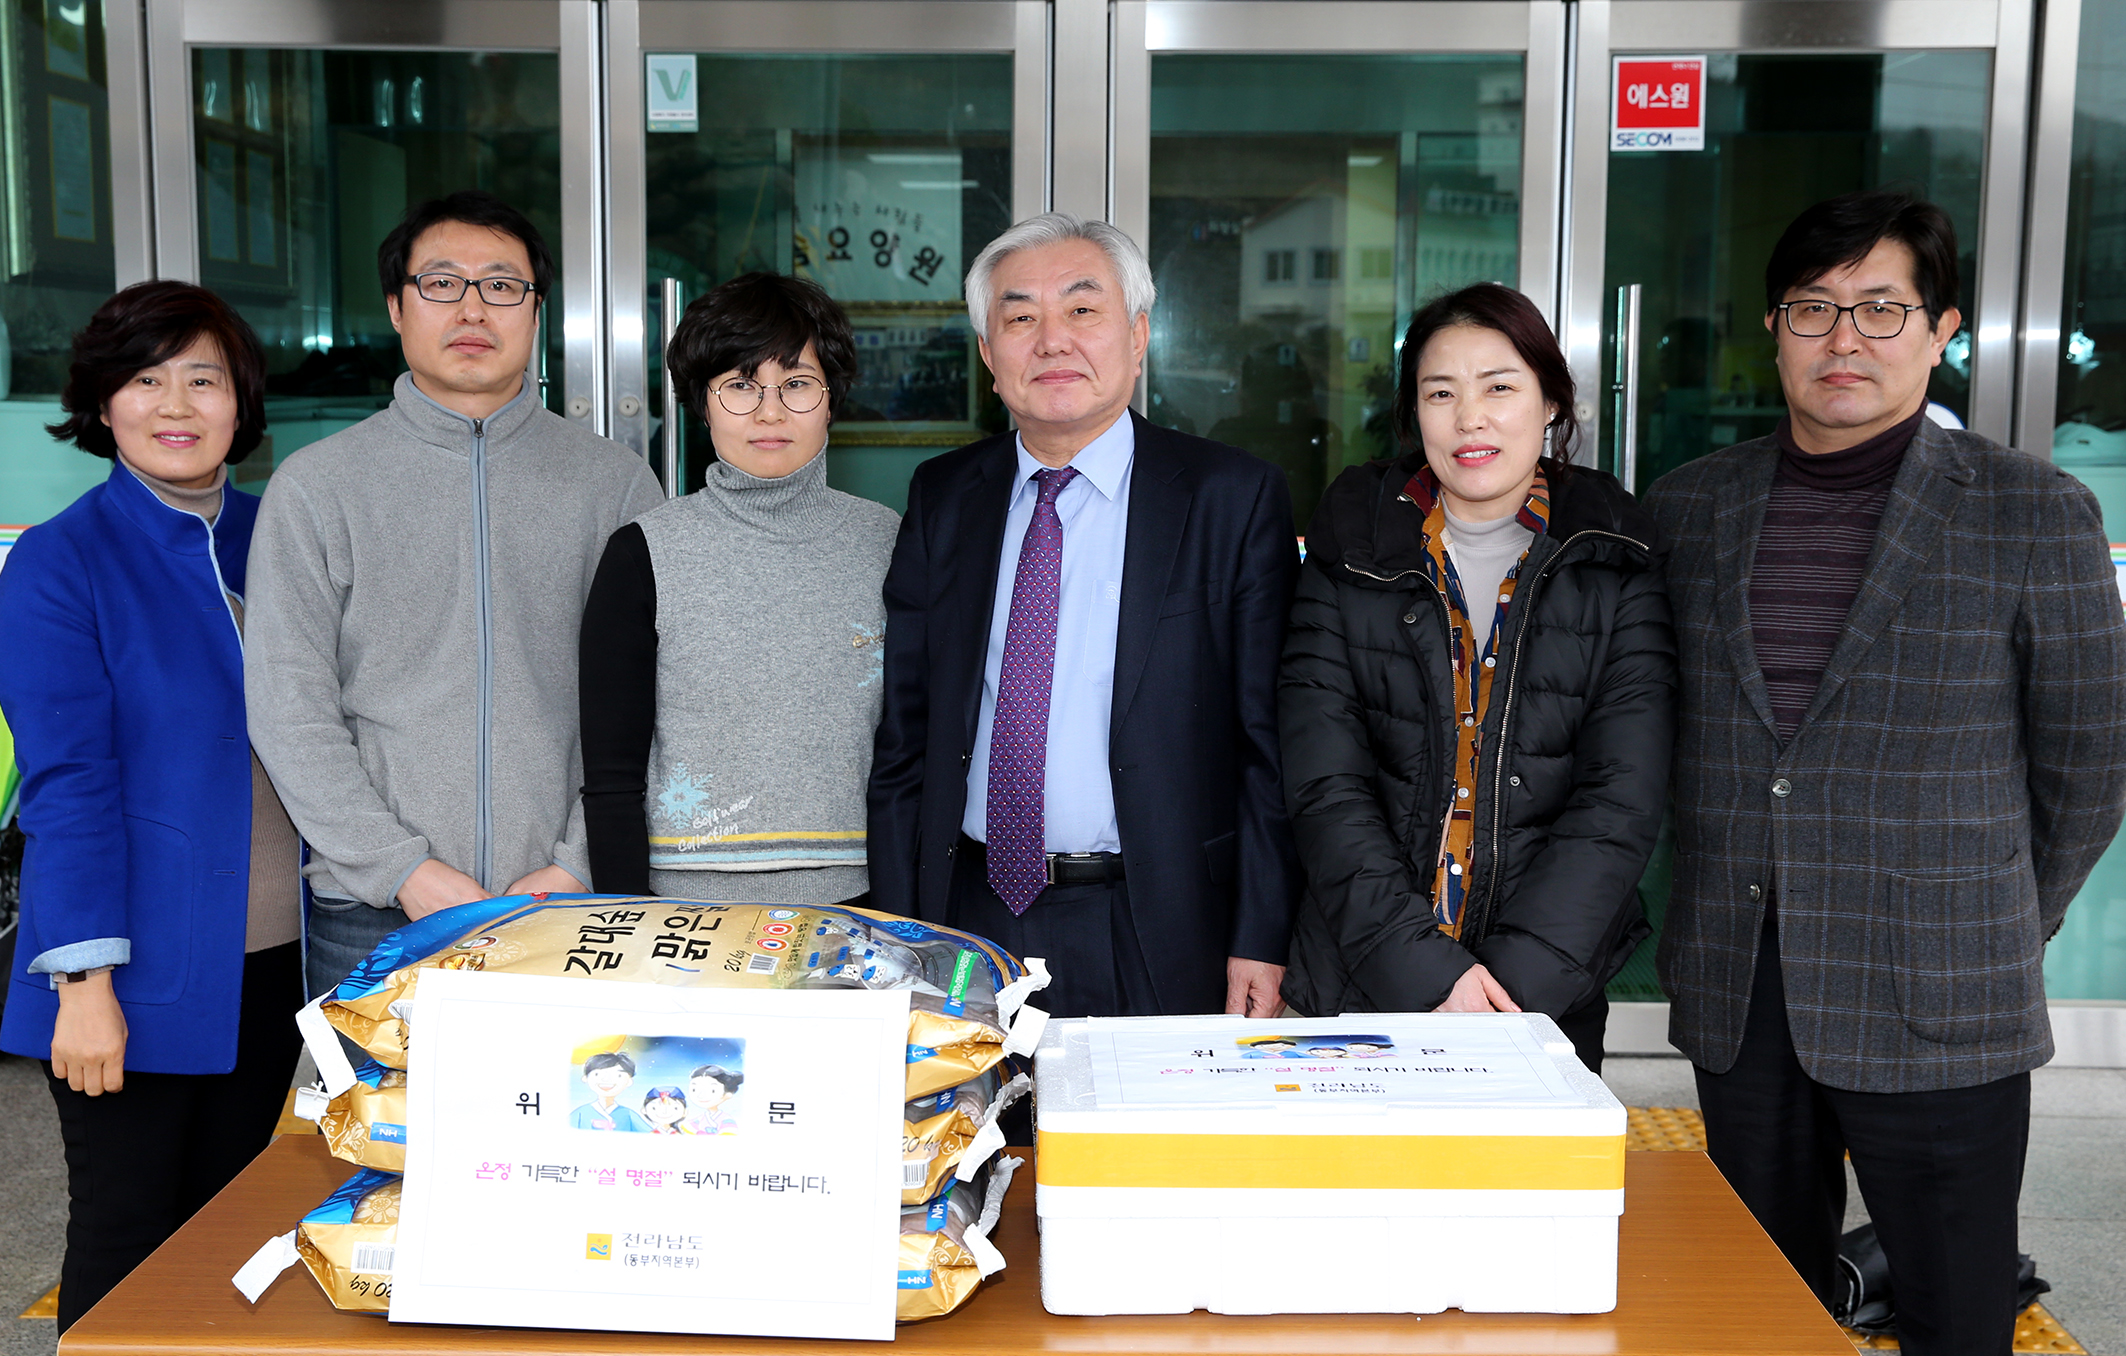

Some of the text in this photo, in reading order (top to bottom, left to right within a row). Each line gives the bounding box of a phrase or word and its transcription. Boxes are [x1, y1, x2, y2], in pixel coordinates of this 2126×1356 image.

[1626, 82, 1690, 110] 에스원
[1616, 132, 1672, 147] SECOM
[563, 910, 646, 975] 갈대숲
[515, 1092, 796, 1125] 위 문
[379, 1127, 398, 1138] NH
[475, 1161, 512, 1181] 온정
[521, 1163, 579, 1184] 가득한
[682, 1171, 738, 1191] 되시기
[748, 1174, 831, 1195] 바랍니다.
[931, 1203, 944, 1219] NH
[621, 1232, 704, 1251] 전라남도
[624, 1252, 700, 1270] (동부지역본부)
[907, 1275, 927, 1285] NH
